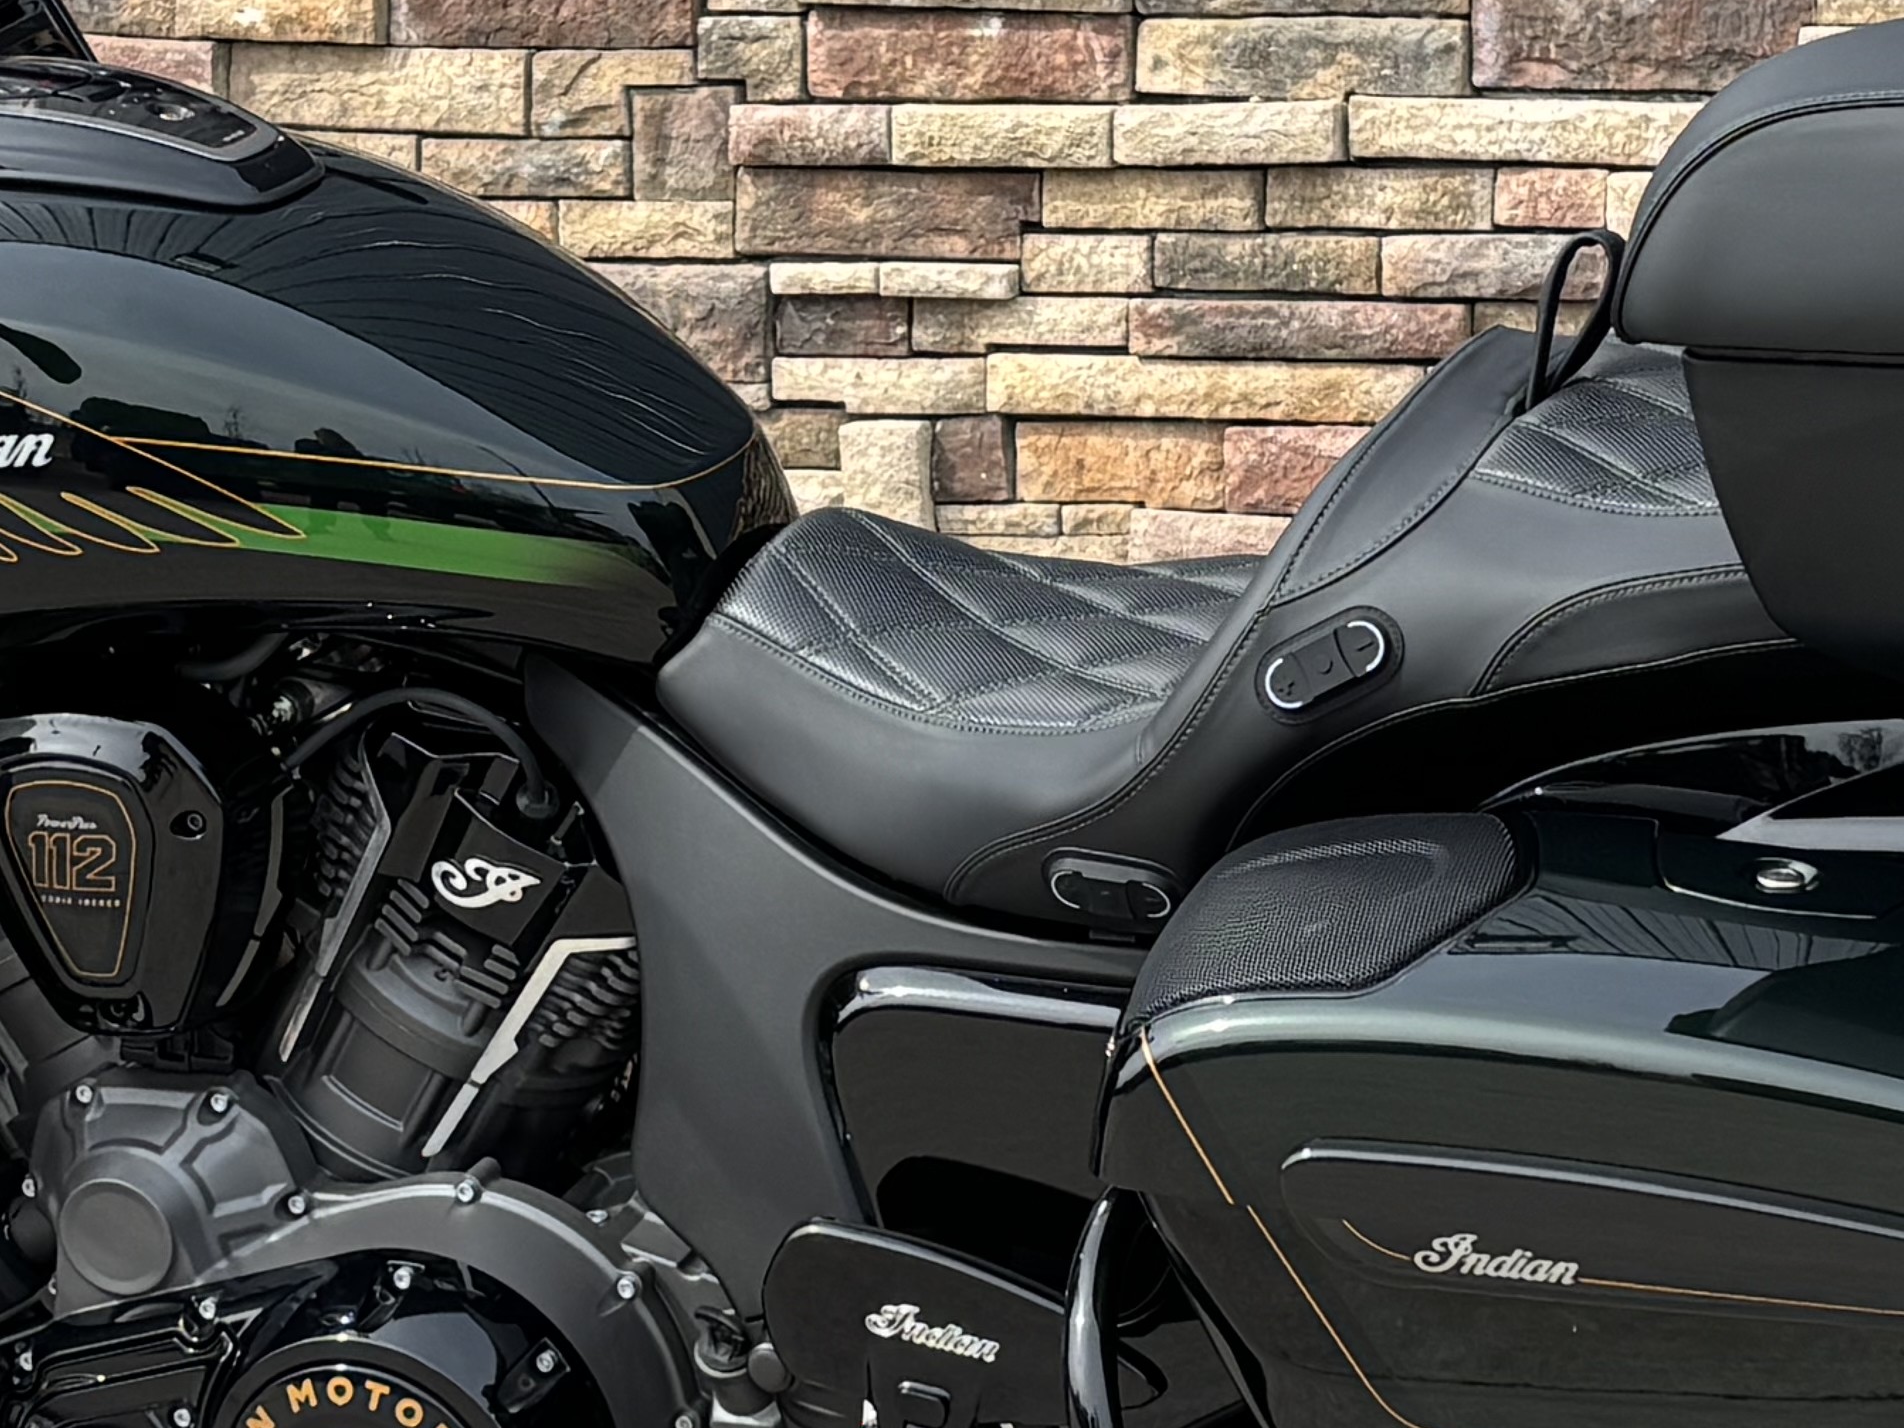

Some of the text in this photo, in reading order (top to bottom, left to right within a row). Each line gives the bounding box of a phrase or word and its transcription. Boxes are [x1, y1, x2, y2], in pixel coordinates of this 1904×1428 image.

[28, 831, 117, 892] 112
[1413, 1233, 1579, 1285] Indian
[864, 1303, 1000, 1363] Indian
